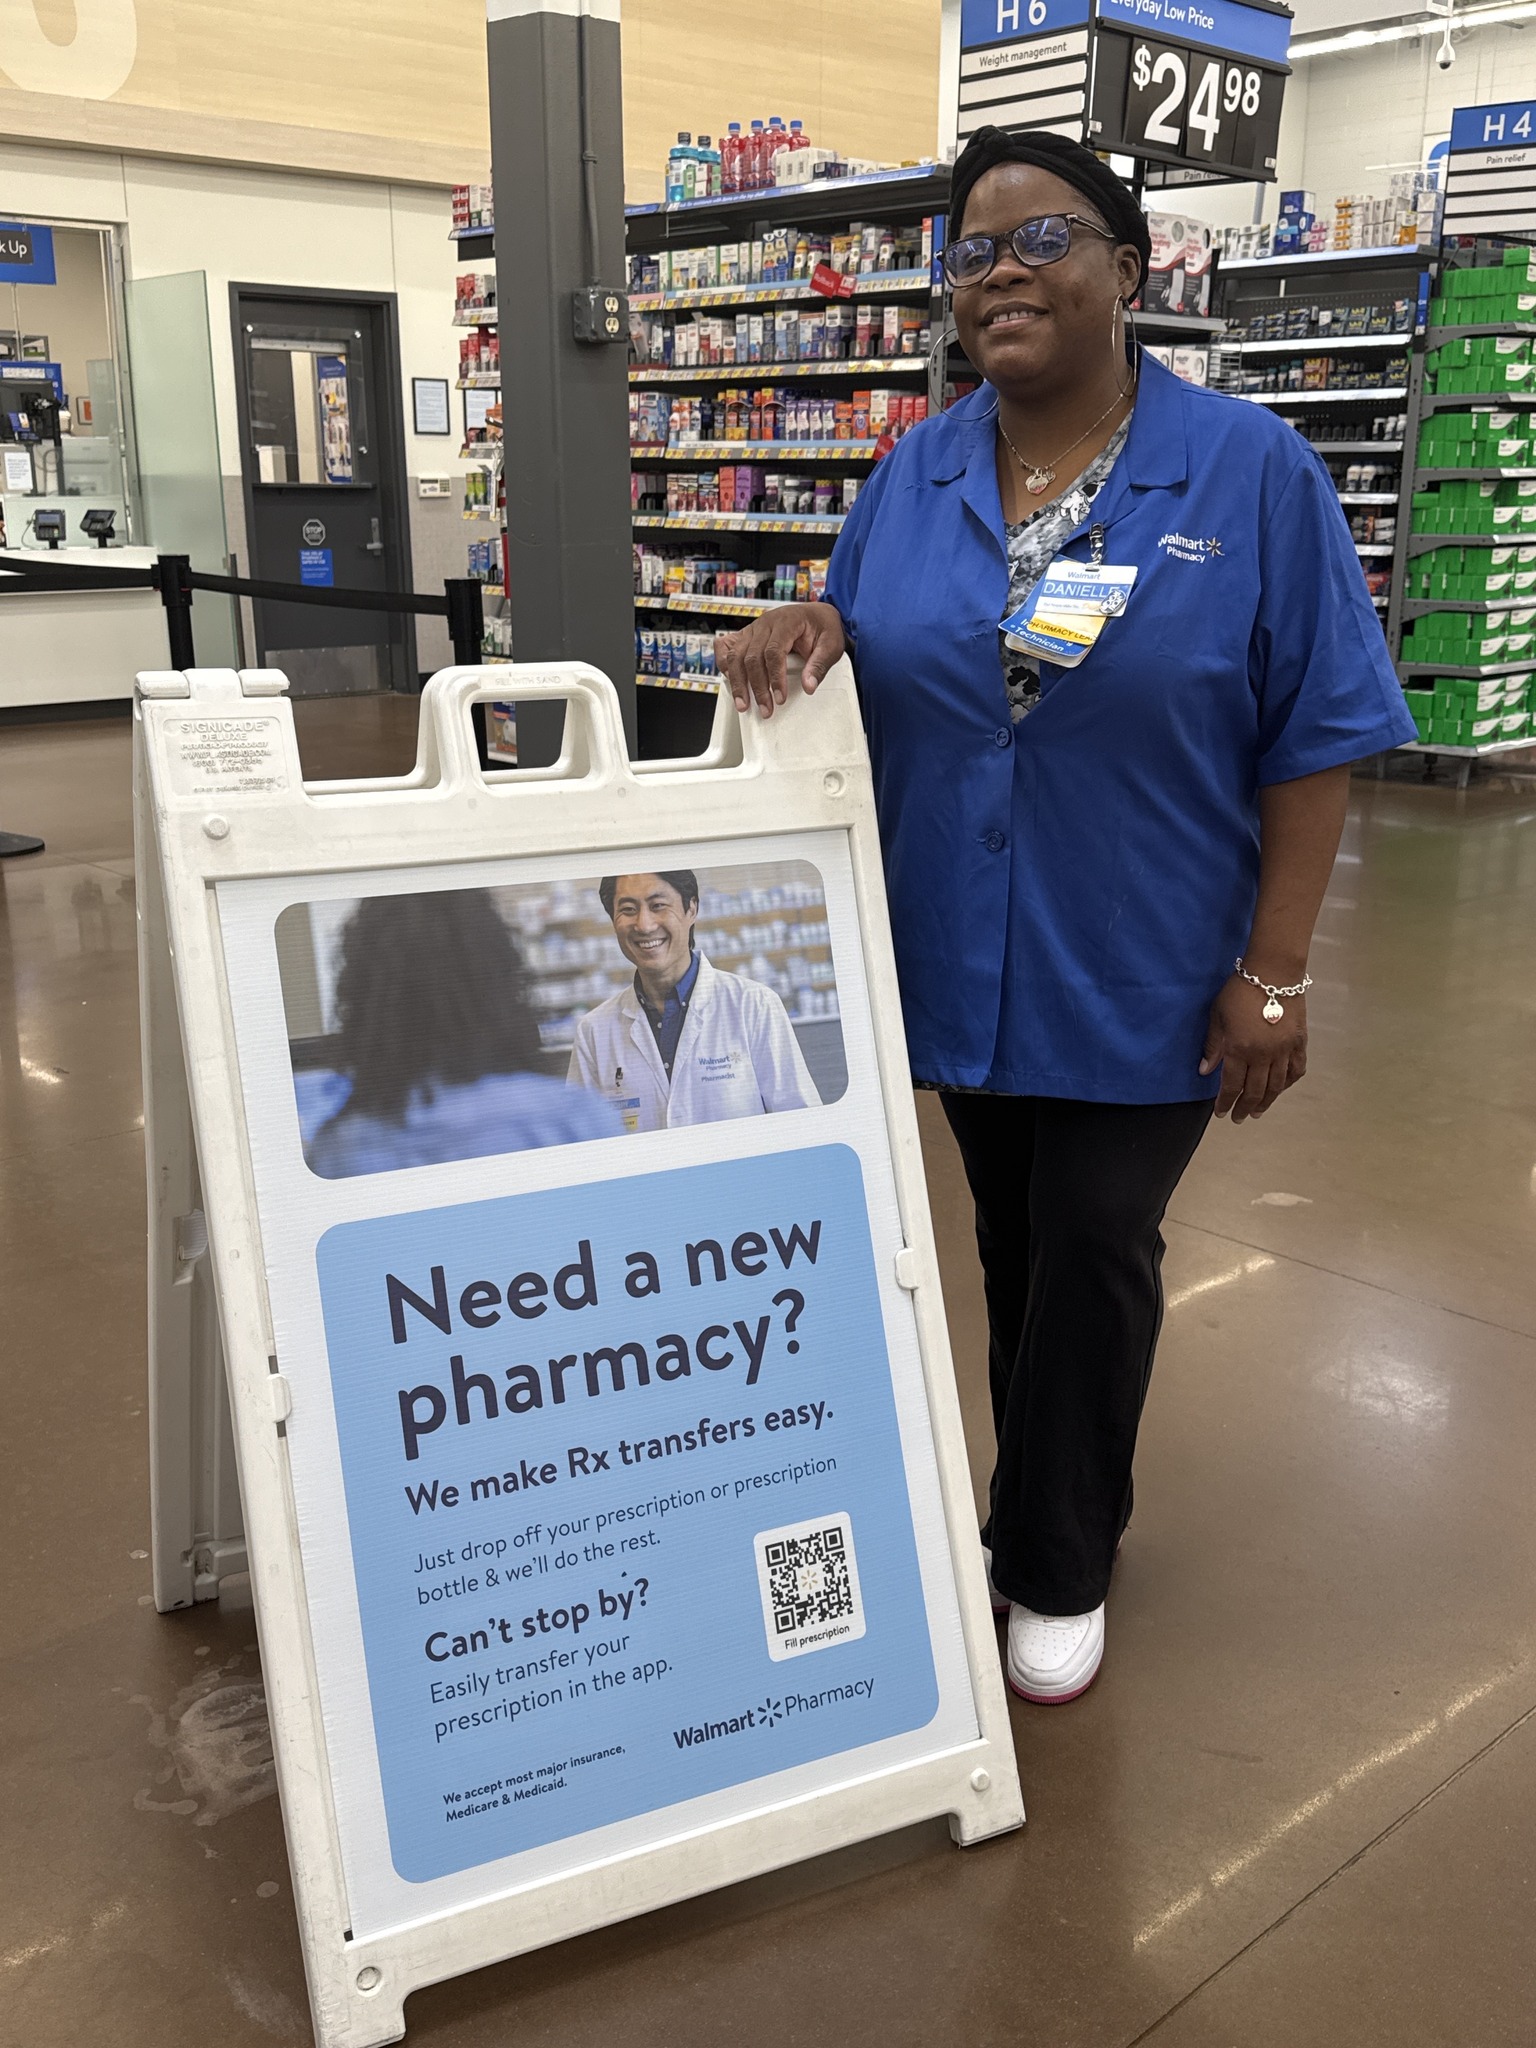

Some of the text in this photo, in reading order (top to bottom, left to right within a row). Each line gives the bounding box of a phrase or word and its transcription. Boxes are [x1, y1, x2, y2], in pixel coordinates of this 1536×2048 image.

[1111, 0, 1215, 30] eryday Low Price
[979, 42, 1067, 67] Weight management
[1486, 153, 1526, 164] Pain relief
[1184, 171, 1201, 181] Pain
[8, 240, 27, 258] Up
[1158, 532, 1206, 551] Walmart
[1167, 545, 1206, 564] Pharmacy
[1067, 571, 1101, 580] Walmart
[1015, 626, 1065, 652] Technician
[1029, 620, 1075, 637] PHARMACY
[1075, 631, 1095, 642] LEA
[537, 675, 562, 684] SAND
[200, 733, 248, 742] DELUXE
[698, 1054, 731, 1066] Walmart
[701, 1072, 736, 1082] Pharmacist
[386, 1220, 822, 1344] Need a new
[398, 1288, 805, 1461] pharmacy?
[404, 1401, 833, 1515] We make Rx transfers easy.
[414, 1458, 836, 1573] Just drop off your prescription or prescription
[418, 1530, 660, 1605] bottle & we'll do the rest.
[425, 1578, 649, 1662] Can't stop by?
[784, 1625, 850, 1649] Fill prescription
[430, 1636, 630, 1704] Easily transfer your
[435, 1659, 672, 1743] prescription in the app.
[673, 1678, 874, 1749] Walmart Pharmacy
[443, 1746, 625, 1805] We accept most major insurance,
[446, 1776, 568, 1822] Medicare & Medicaid.
